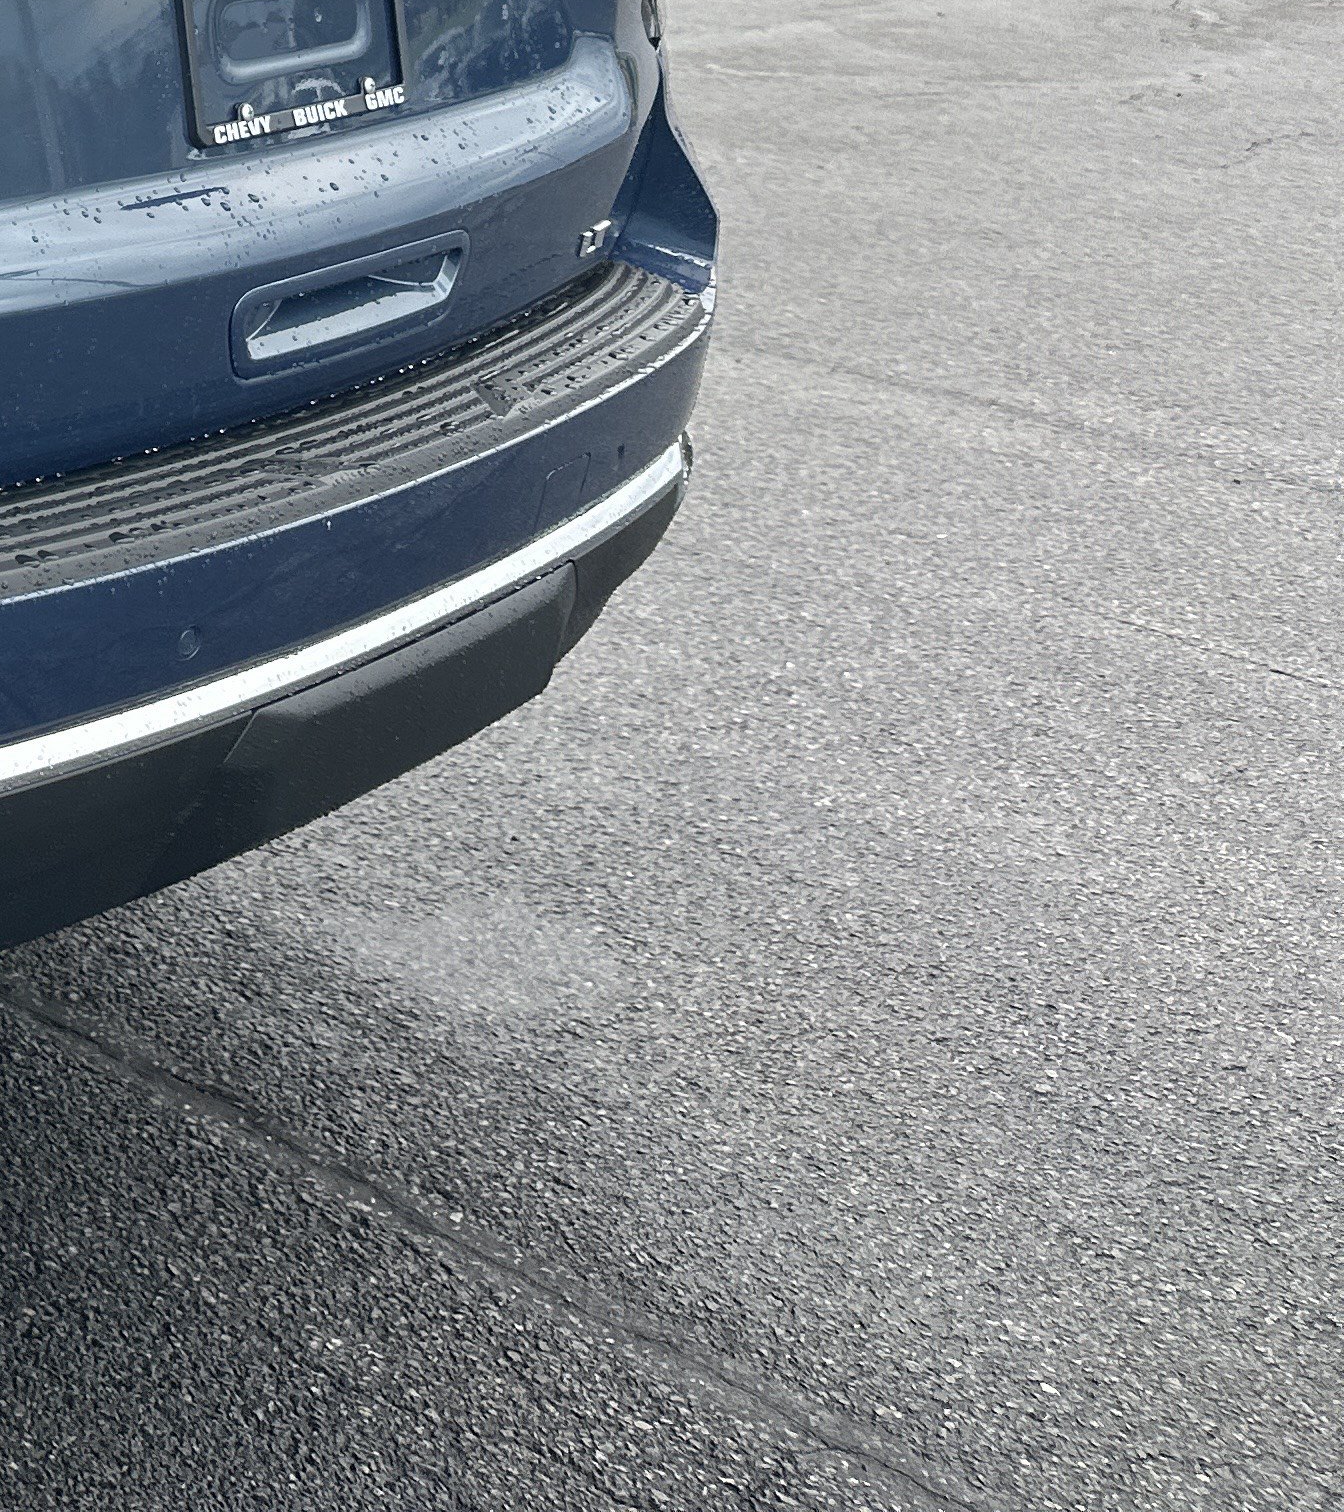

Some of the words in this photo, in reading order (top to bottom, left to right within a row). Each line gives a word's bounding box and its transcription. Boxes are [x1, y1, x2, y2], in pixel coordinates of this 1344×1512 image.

[213, 114, 272, 145] CHEVY
[292, 99, 349, 127] BUICK
[364, 86, 405, 111] GMC
[579, 219, 612, 258] LT
